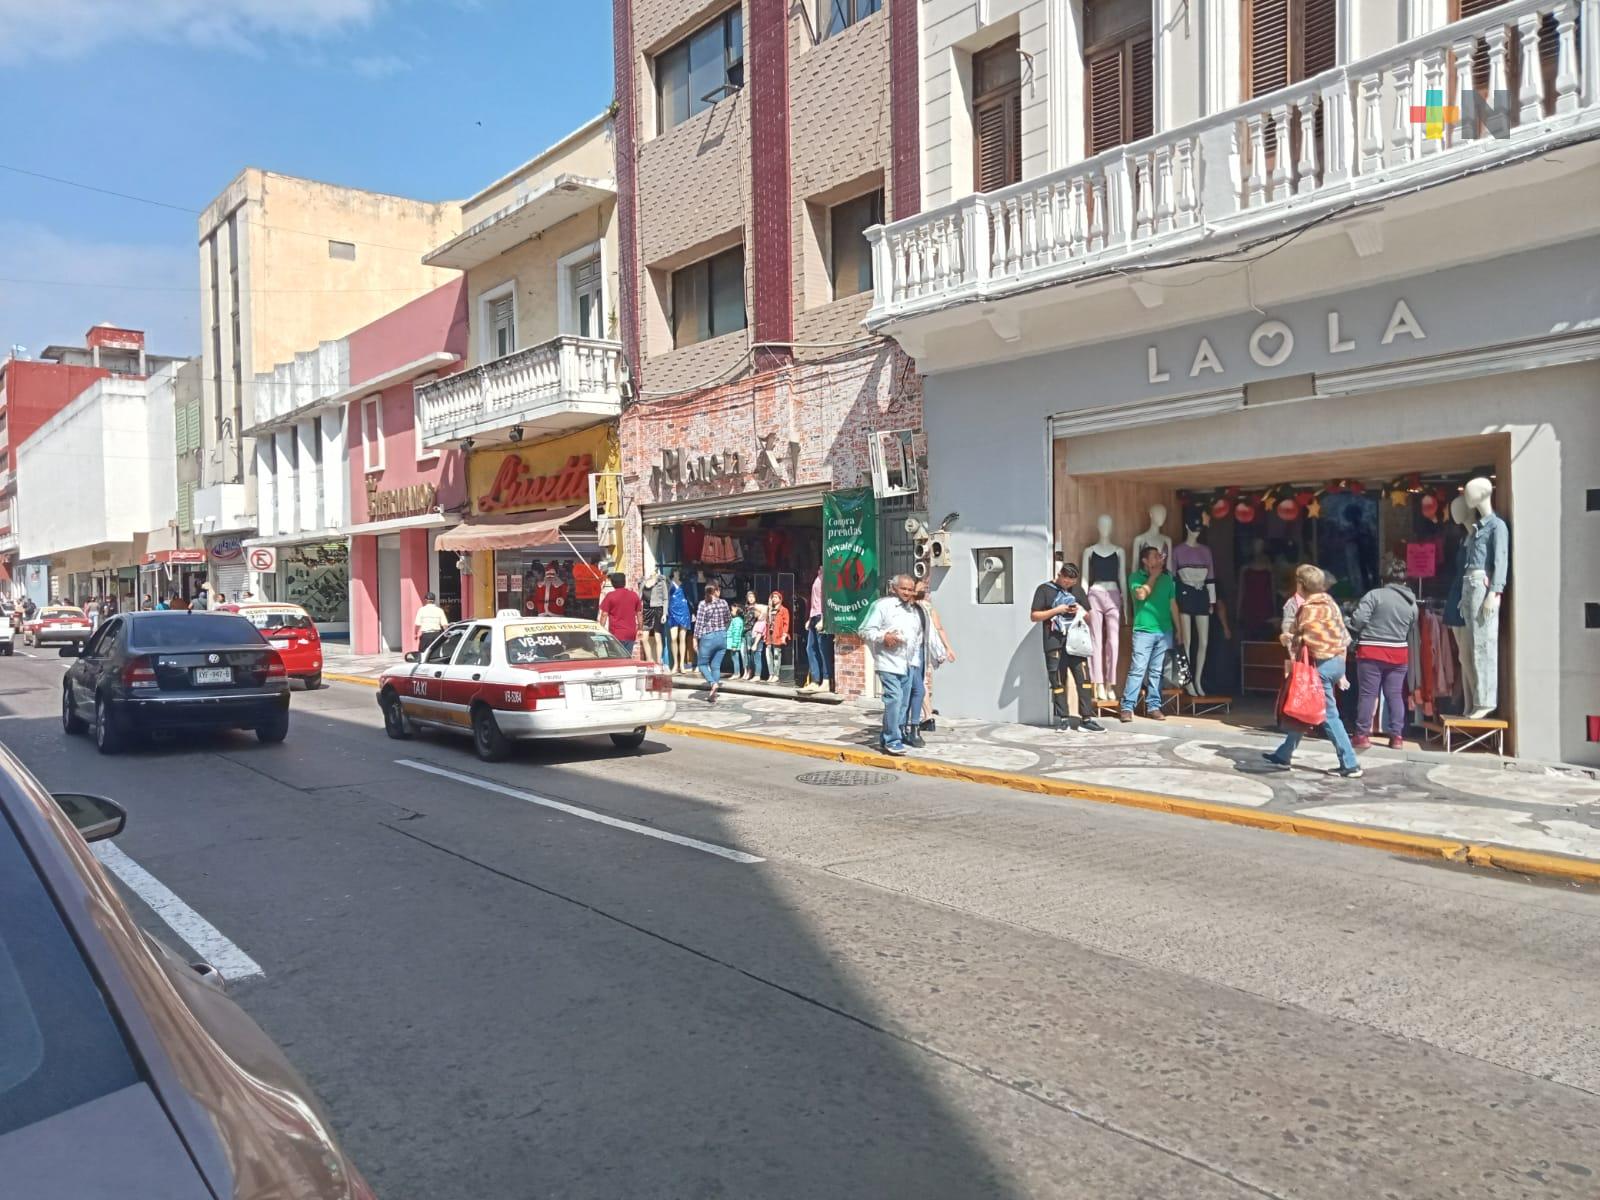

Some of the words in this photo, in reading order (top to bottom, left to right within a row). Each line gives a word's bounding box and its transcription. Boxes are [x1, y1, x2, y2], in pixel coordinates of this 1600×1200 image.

[828, 525, 863, 540] prendas
[826, 598, 869, 613] descuento
[412, 680, 428, 696] TAXI
